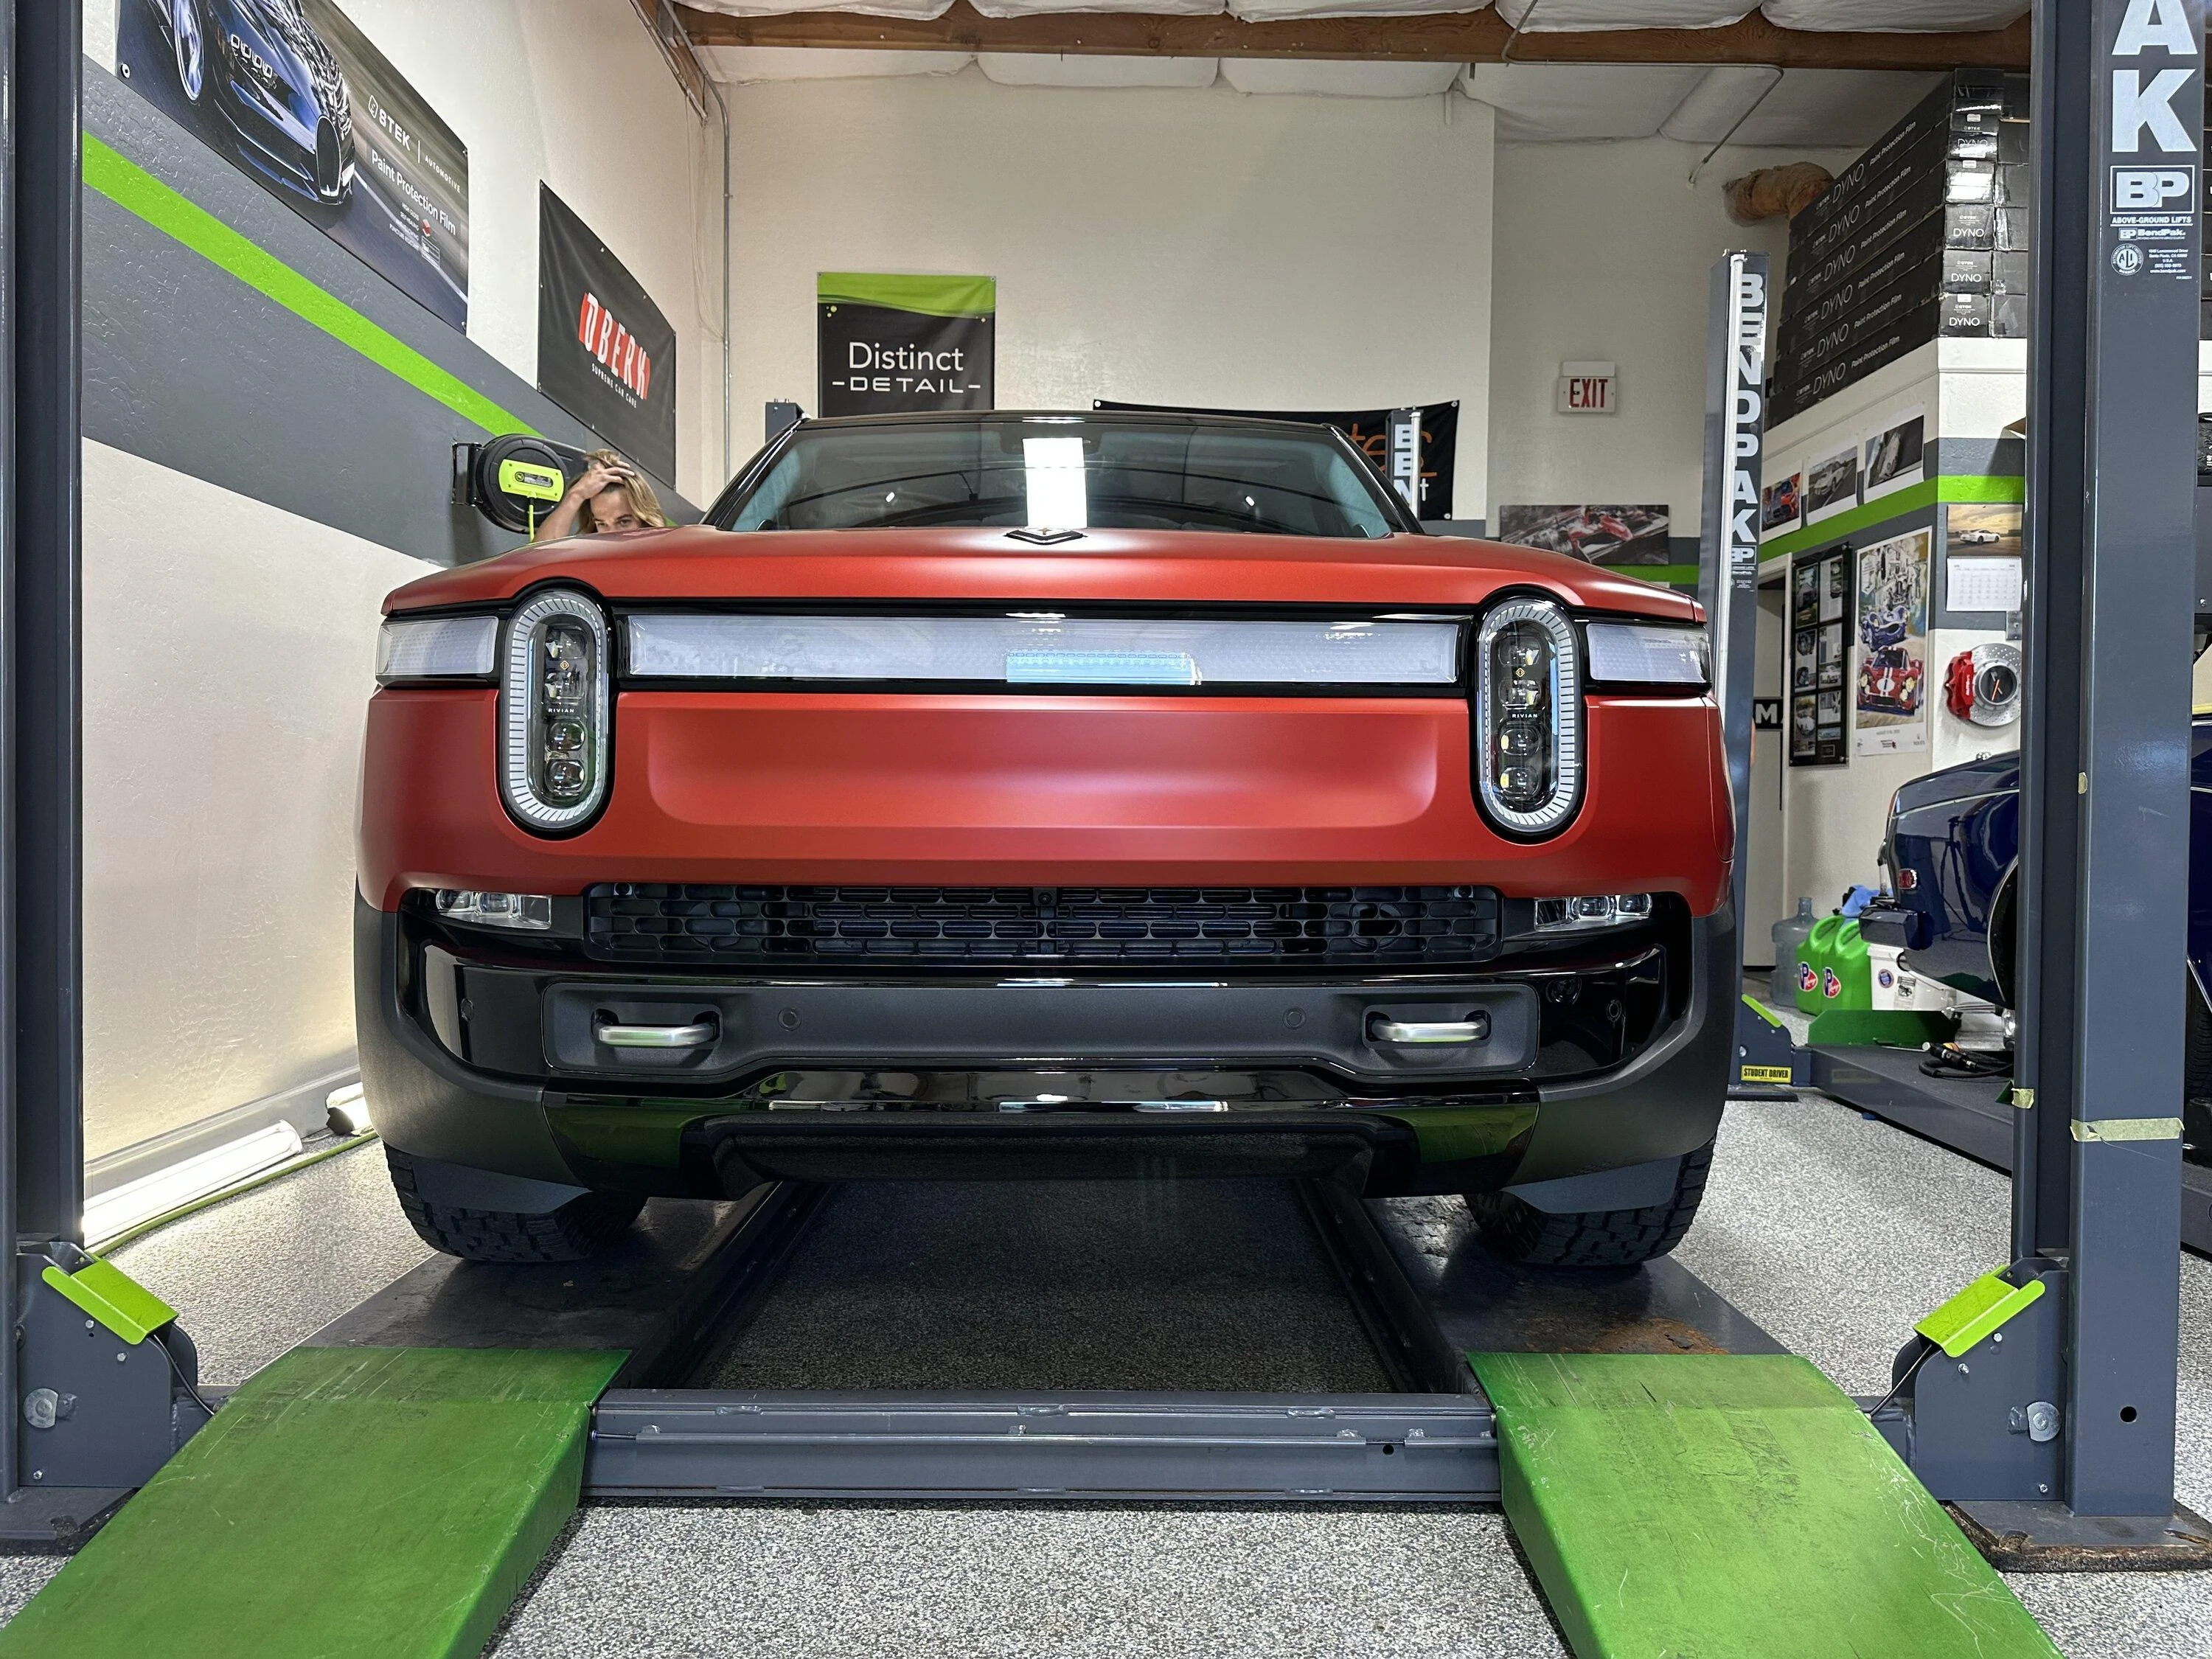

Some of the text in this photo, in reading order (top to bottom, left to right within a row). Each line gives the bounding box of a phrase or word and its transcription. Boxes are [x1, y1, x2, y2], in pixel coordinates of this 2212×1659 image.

[1881, 131, 1905, 156] Protection
[1905, 122, 1916, 134] Film
[425, 155, 461, 194] AUTOMOTIVE
[1832, 163, 1864, 204] DYNO
[1877, 175, 1900, 198] Protection
[1900, 166, 1911, 179] Film
[2116, 171, 2190, 208] BP
[372, 148, 395, 182] Paint
[397, 170, 439, 220] Protection
[439, 209, 456, 236] Film
[1829, 204, 1860, 243] DYNO
[1872, 218, 1896, 240] Protection
[1896, 209, 1907, 221] Film
[1953, 228, 1984, 237] DYNO
[1824, 245, 1855, 282] DYNO
[1870, 260, 1893, 281] Protection
[1894, 252, 1905, 263] Film
[1951, 273, 1982, 282] DYNO
[1820, 284, 1853, 320] DYNO
[1866, 301, 1890, 321] Protection
[1891, 294, 1902, 305] Film
[1949, 317, 1980, 327] DYNO
[849, 341, 964, 371] Distinct
[1817, 323, 1848, 358] DYNO
[1863, 342, 1888, 361] Protection
[1888, 335, 1900, 347] Film
[591, 363, 637, 408] SUPREME CAR CARE
[1569, 378, 1608, 408] EXIT
[1812, 362, 1846, 394] DYNO
[1744, 1068, 1789, 1078] STUDENT DRIVER
